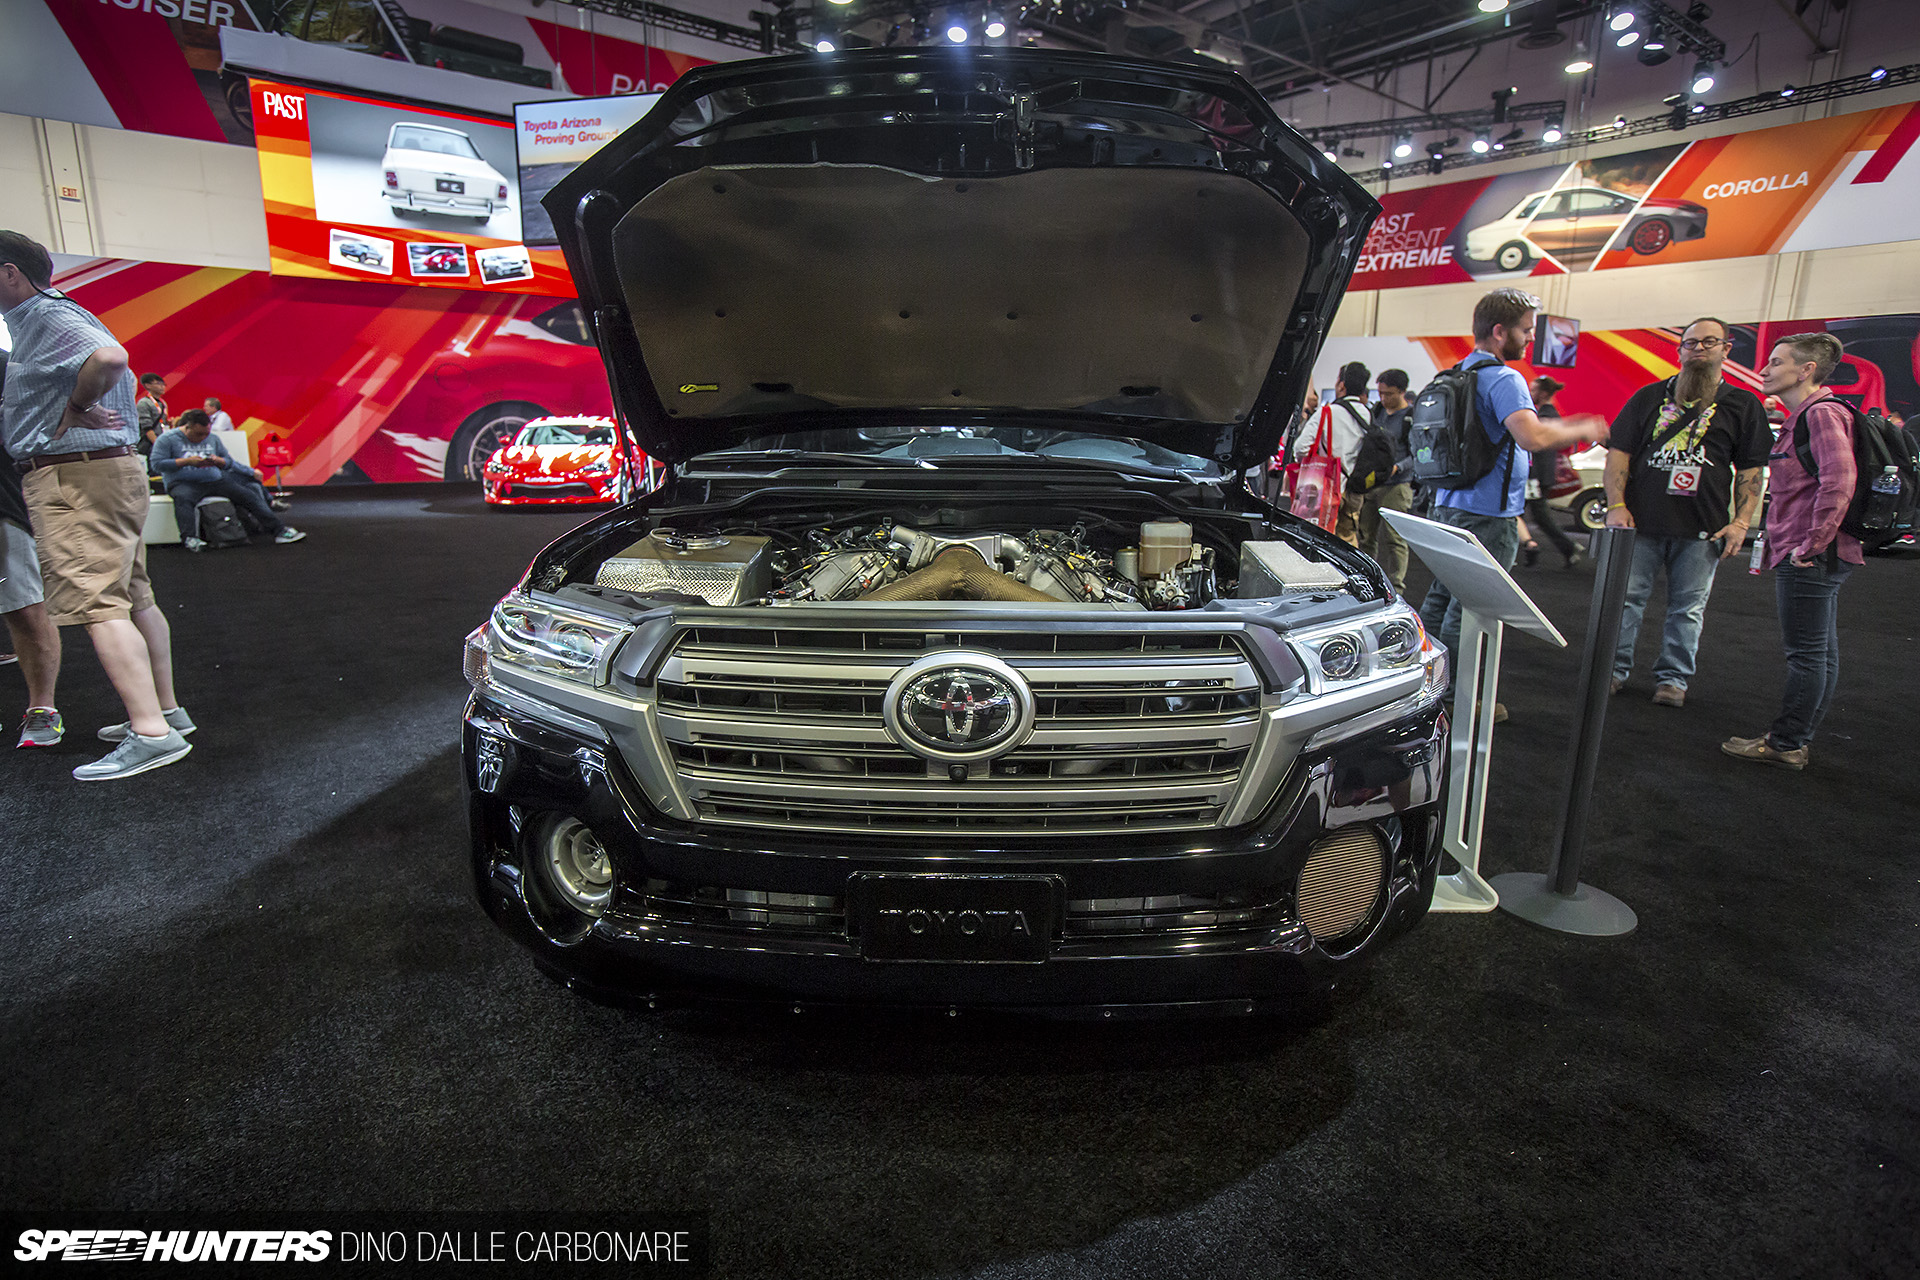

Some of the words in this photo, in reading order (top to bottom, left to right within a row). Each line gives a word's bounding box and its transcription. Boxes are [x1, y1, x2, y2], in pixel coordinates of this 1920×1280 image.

[263, 91, 304, 120] PAST
[523, 120, 557, 133] Toyota
[560, 117, 602, 129] Arizona
[534, 132, 575, 145] Proving
[62, 186, 78, 198] EXIT
[1702, 171, 1809, 200] COROLLA
[1353, 245, 1455, 273] EXTREME
[879, 909, 1032, 937] TOYOTA
